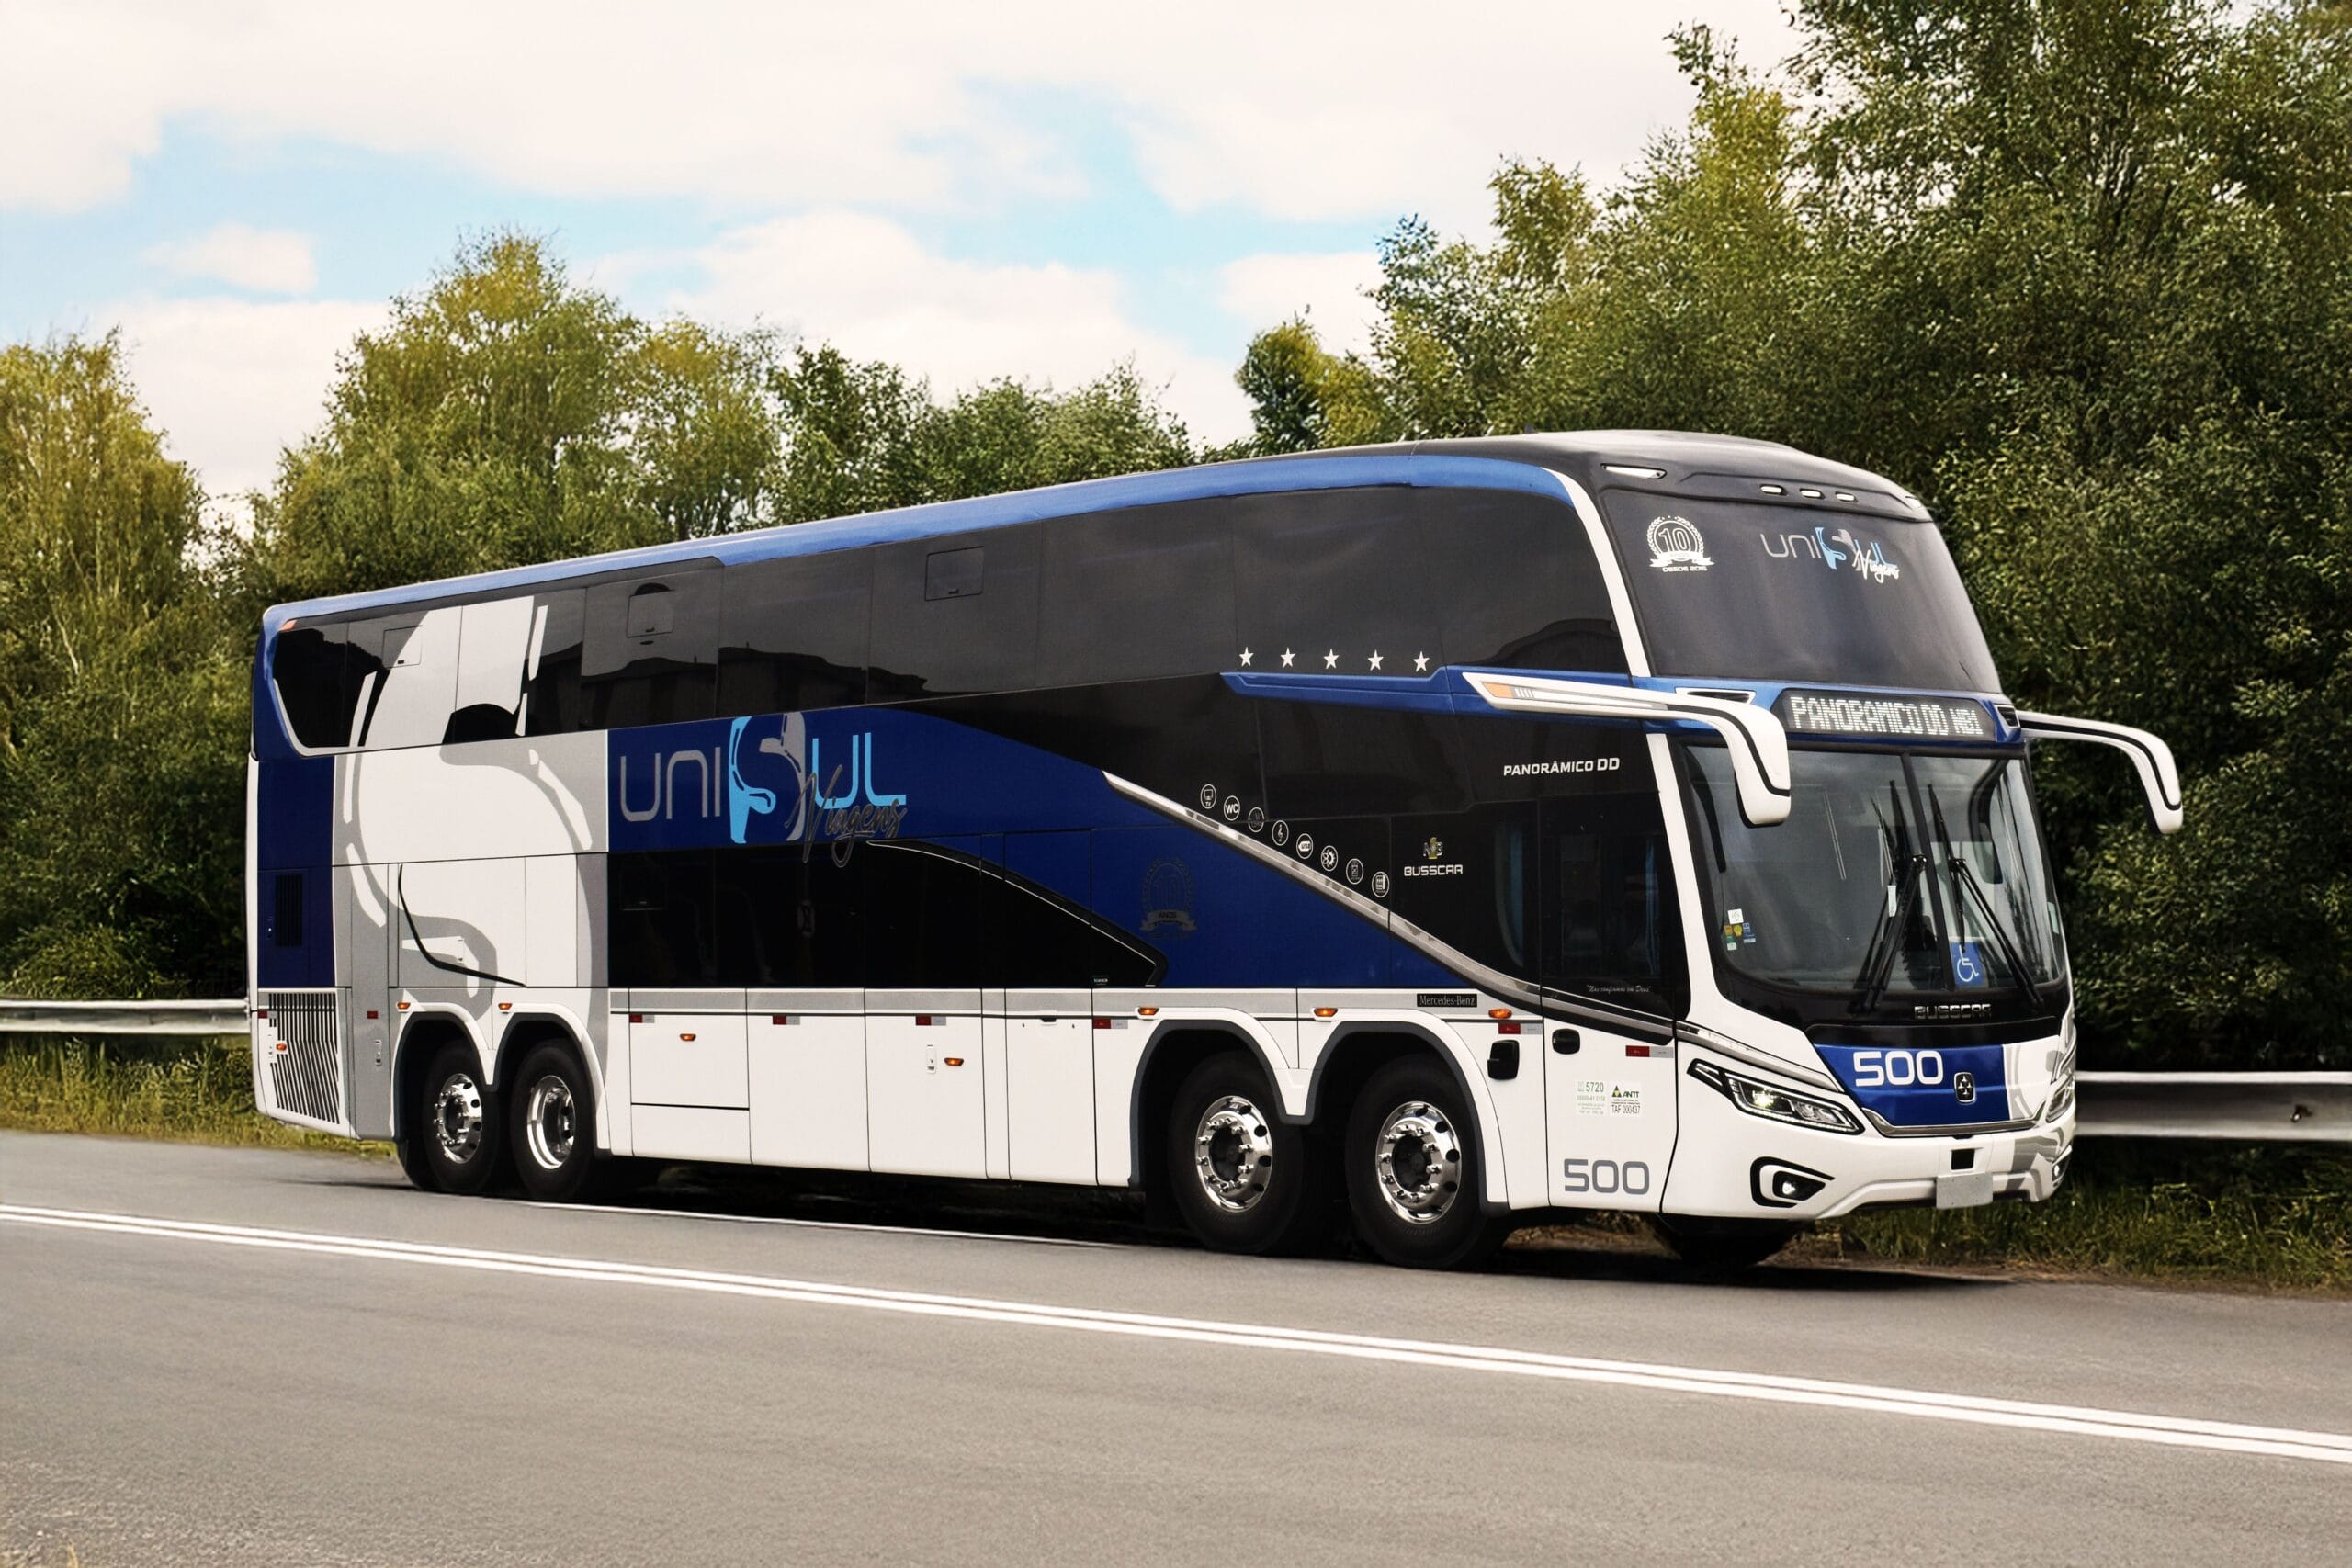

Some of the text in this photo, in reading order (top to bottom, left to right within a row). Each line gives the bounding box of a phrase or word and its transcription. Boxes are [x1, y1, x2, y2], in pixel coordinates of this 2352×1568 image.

[1658, 527, 1691, 552] 10
[1791, 696, 1923, 734] PANORAMICO
[1920, 704, 1949, 735] DD
[1503, 758, 1620, 776] PANORÂMICO DD
[1225, 803, 1238, 814] WC
[1404, 864, 1463, 876] BUSSCAR
[1419, 994, 1476, 1006] Mercedes-Benz
[1914, 1003, 1992, 1020] BUSSCAR
[1852, 1050, 1944, 1087] 500
[1586, 1082, 1604, 1092] 5720
[1611, 1104, 1621, 1113] TAF
[1564, 1158, 1650, 1195] 500
